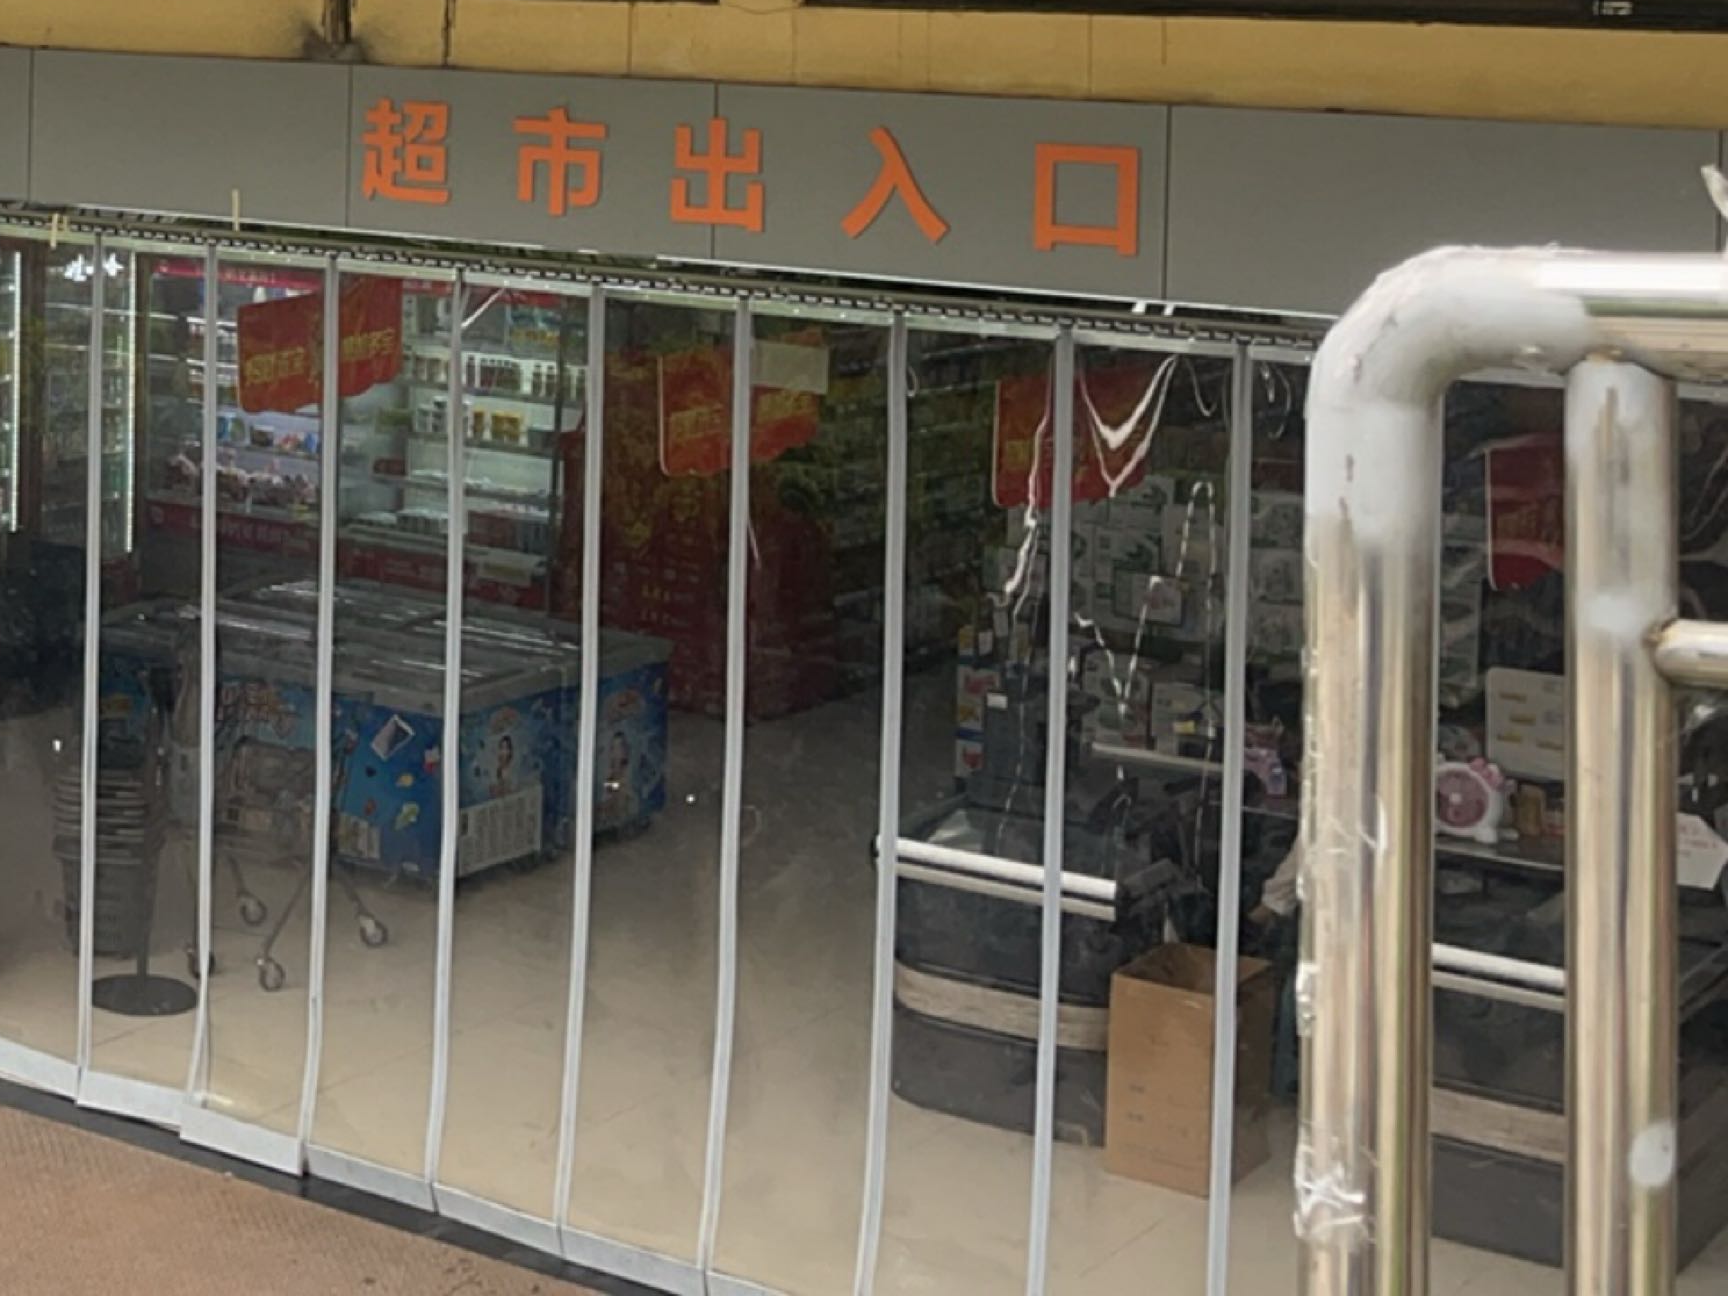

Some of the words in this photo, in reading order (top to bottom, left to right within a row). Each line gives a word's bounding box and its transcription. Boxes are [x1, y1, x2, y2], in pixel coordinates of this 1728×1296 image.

[360, 97, 1143, 257] 超市出入口
